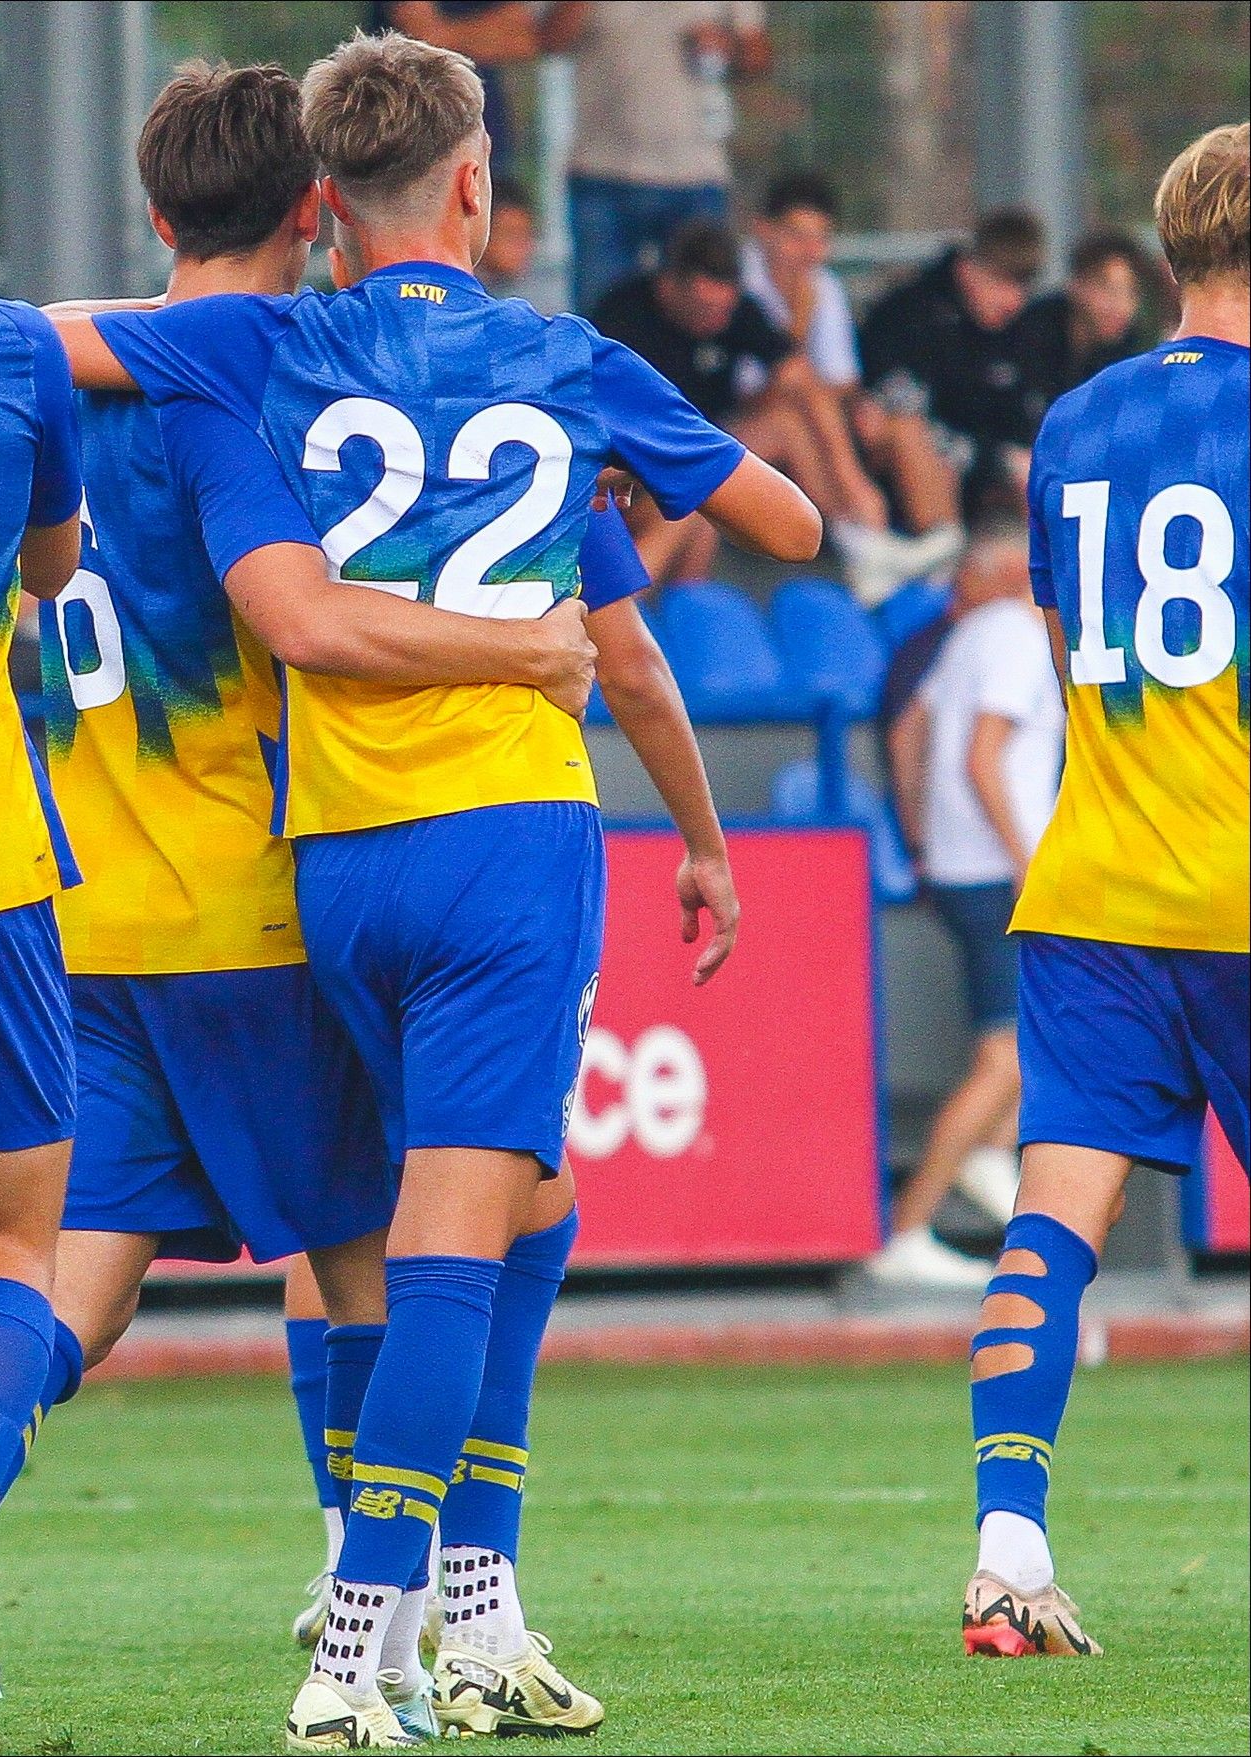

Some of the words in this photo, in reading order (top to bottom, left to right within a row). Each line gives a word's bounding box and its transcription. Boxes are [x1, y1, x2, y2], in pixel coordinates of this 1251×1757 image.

[400, 283, 449, 305] KYIV
[301, 396, 573, 621] 22
[1062, 480, 1236, 688] 18
[566, 1023, 711, 1158] ce
